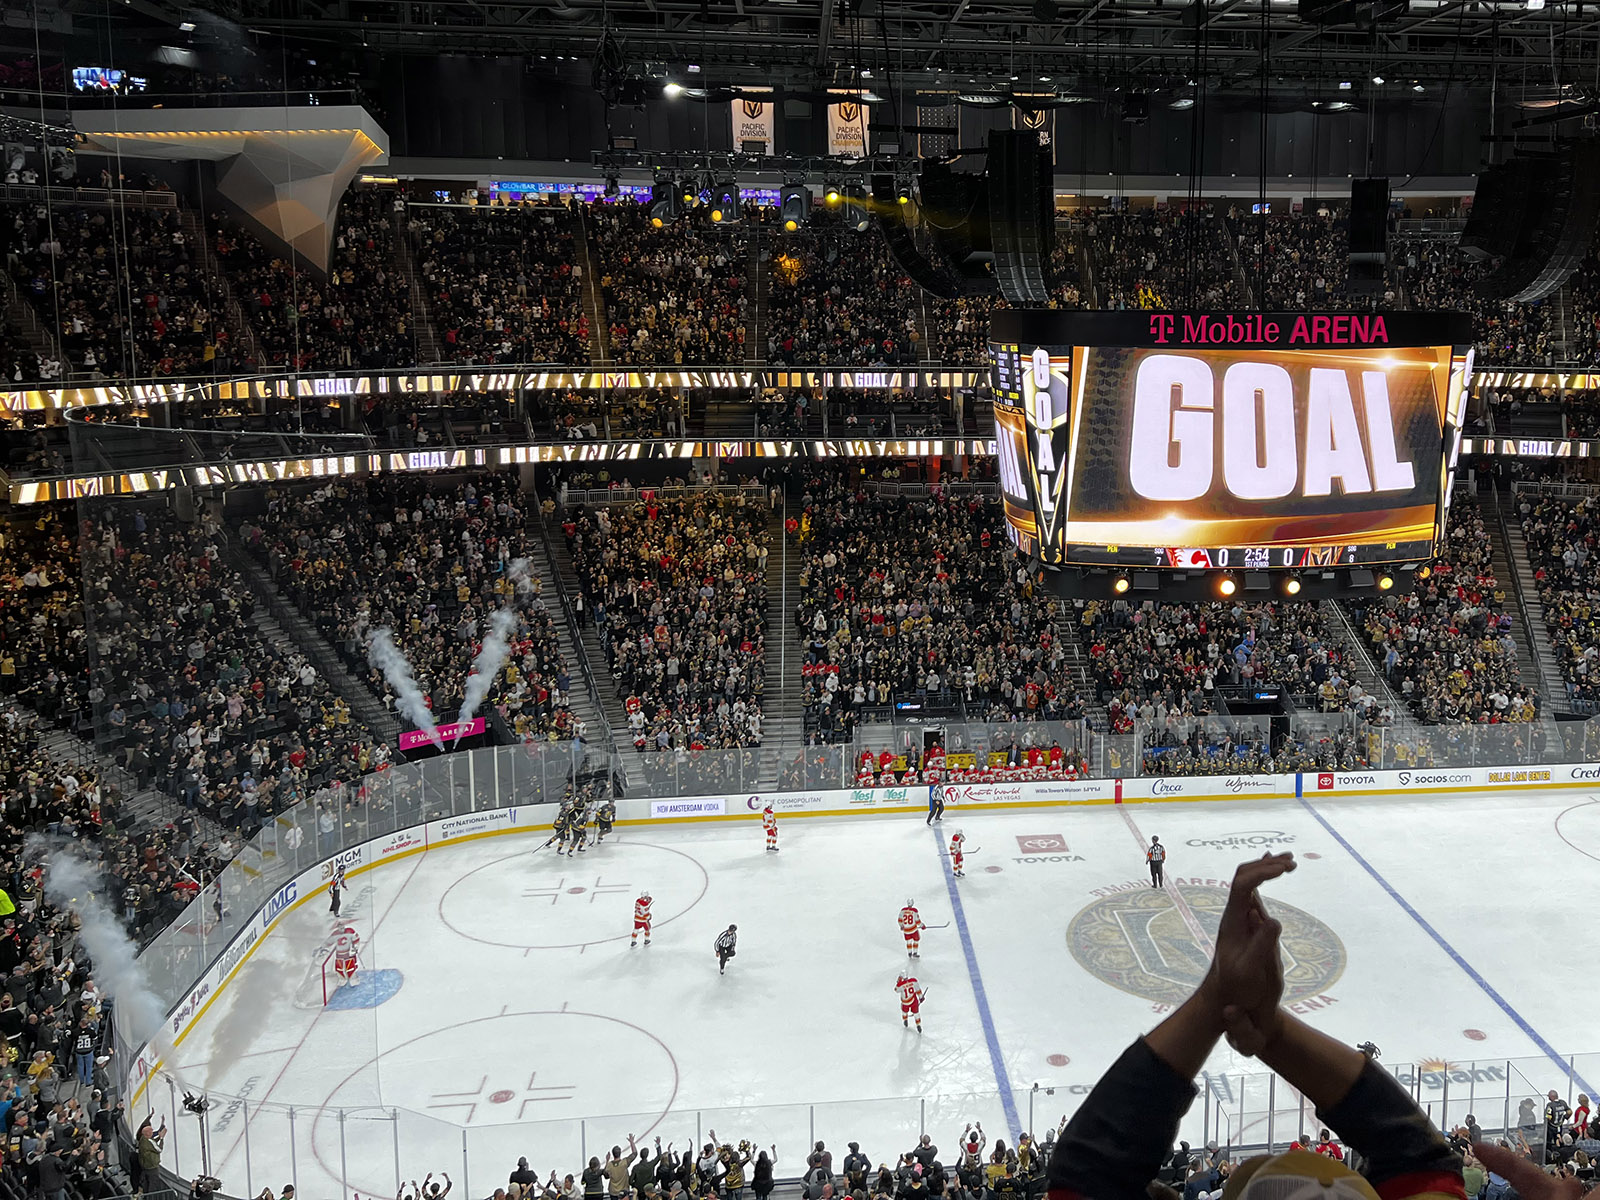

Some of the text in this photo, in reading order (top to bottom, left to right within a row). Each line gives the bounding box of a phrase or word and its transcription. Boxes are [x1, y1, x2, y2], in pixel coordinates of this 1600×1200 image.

[740, 129, 767, 137] DIVISION
[1181, 314, 1280, 343] Mobile
[1288, 315, 1389, 343] ARENA
[314, 378, 354, 395] GOAL
[855, 372, 888, 388] GOAL
[1032, 348, 1056, 512] GOAL
[1129, 353, 1416, 501] GOAL
[1519, 440, 1555, 457] GOAL
[409, 450, 449, 469] GOAL
[1156, 556, 1162, 566] 7
[1218, 548, 1229, 567] 0
[1244, 548, 1270, 562] 2:54
[1283, 548, 1294, 567] 0
[1349, 553, 1355, 564] 8
[1337, 775, 1376, 785] TOYOTA
[1488, 770, 1551, 783] DOLLAR LOAN CENTER
[1152, 778, 1184, 795] Circa
[777, 797, 822, 805] COSMOPOLITAN
[853, 789, 875, 802] Yes!
[886, 788, 908, 801] Yes!
[656, 803, 720, 813] NEW AMSTERDAM VODKA
[442, 813, 509, 831] CITY NATIONAL BANK
[335, 848, 361, 867] MGM
[1012, 855, 1086, 864] TOYOTA
[1175, 877, 1231, 889] AREN
[262, 881, 297, 927] UMC
[902, 914, 914, 925] 28
[1554, 1111, 1566, 1124] 17
